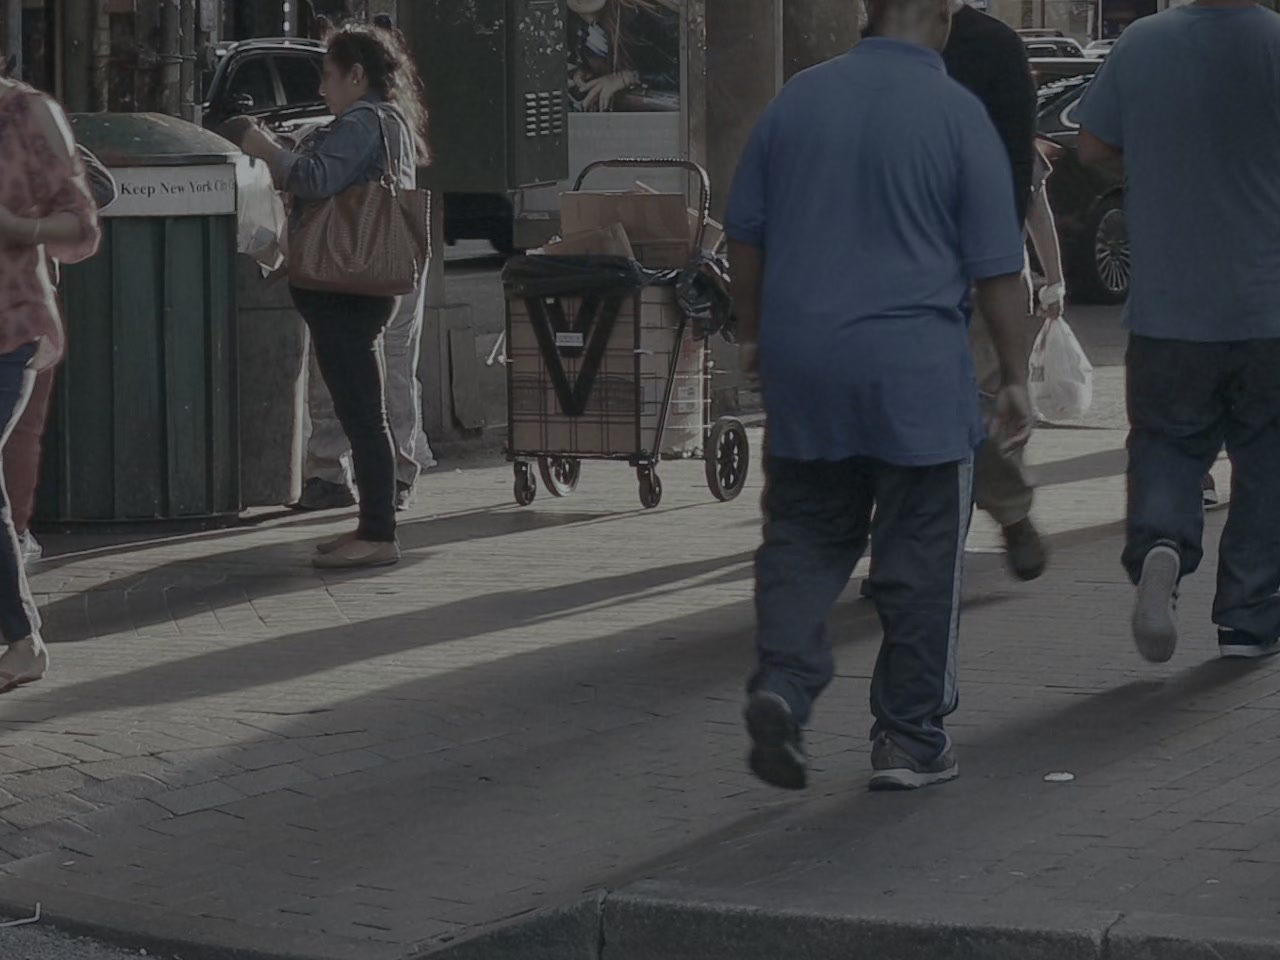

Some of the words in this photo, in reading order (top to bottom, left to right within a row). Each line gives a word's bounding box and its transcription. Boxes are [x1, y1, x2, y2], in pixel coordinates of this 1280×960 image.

[120, 183, 156, 198] Keep
[160, 182, 186, 195] New
[188, 180, 212, 193] York
